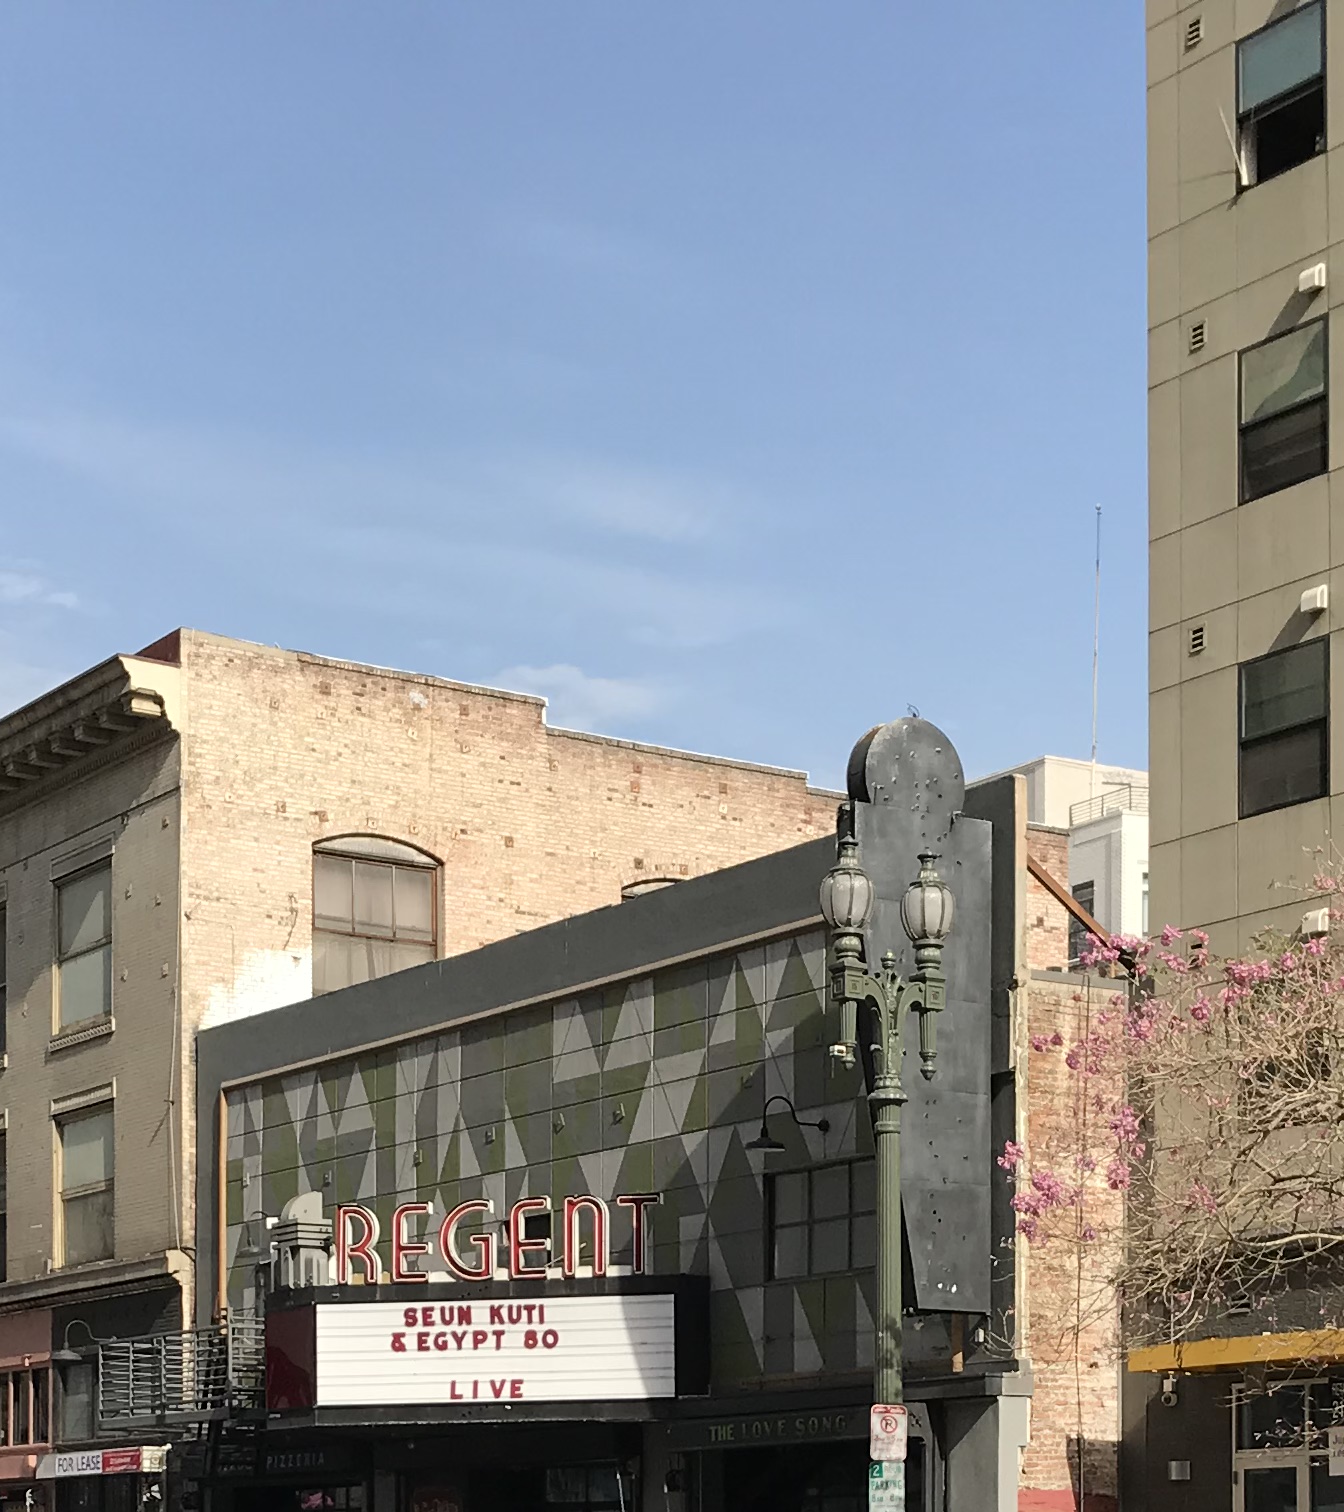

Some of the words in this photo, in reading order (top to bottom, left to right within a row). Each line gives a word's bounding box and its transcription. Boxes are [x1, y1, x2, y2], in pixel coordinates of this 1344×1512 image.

[337, 1194, 663, 1285] REGENT
[404, 1305, 472, 1327] SEUN
[490, 1304, 545, 1325] KUTI
[391, 1332, 406, 1352] &
[417, 1330, 506, 1351] EGYPT
[524, 1328, 560, 1349] 80
[450, 1379, 524, 1399] LIVE
[709, 1424, 735, 1441] THE
[741, 1419, 786, 1438] LOVE
[795, 1415, 847, 1437] SONG
[58, 1458, 74, 1472] FOR
[76, 1455, 101, 1471] LEASE
[266, 1452, 325, 1470] PIZZERIA
[872, 1465, 880, 1476] 2
